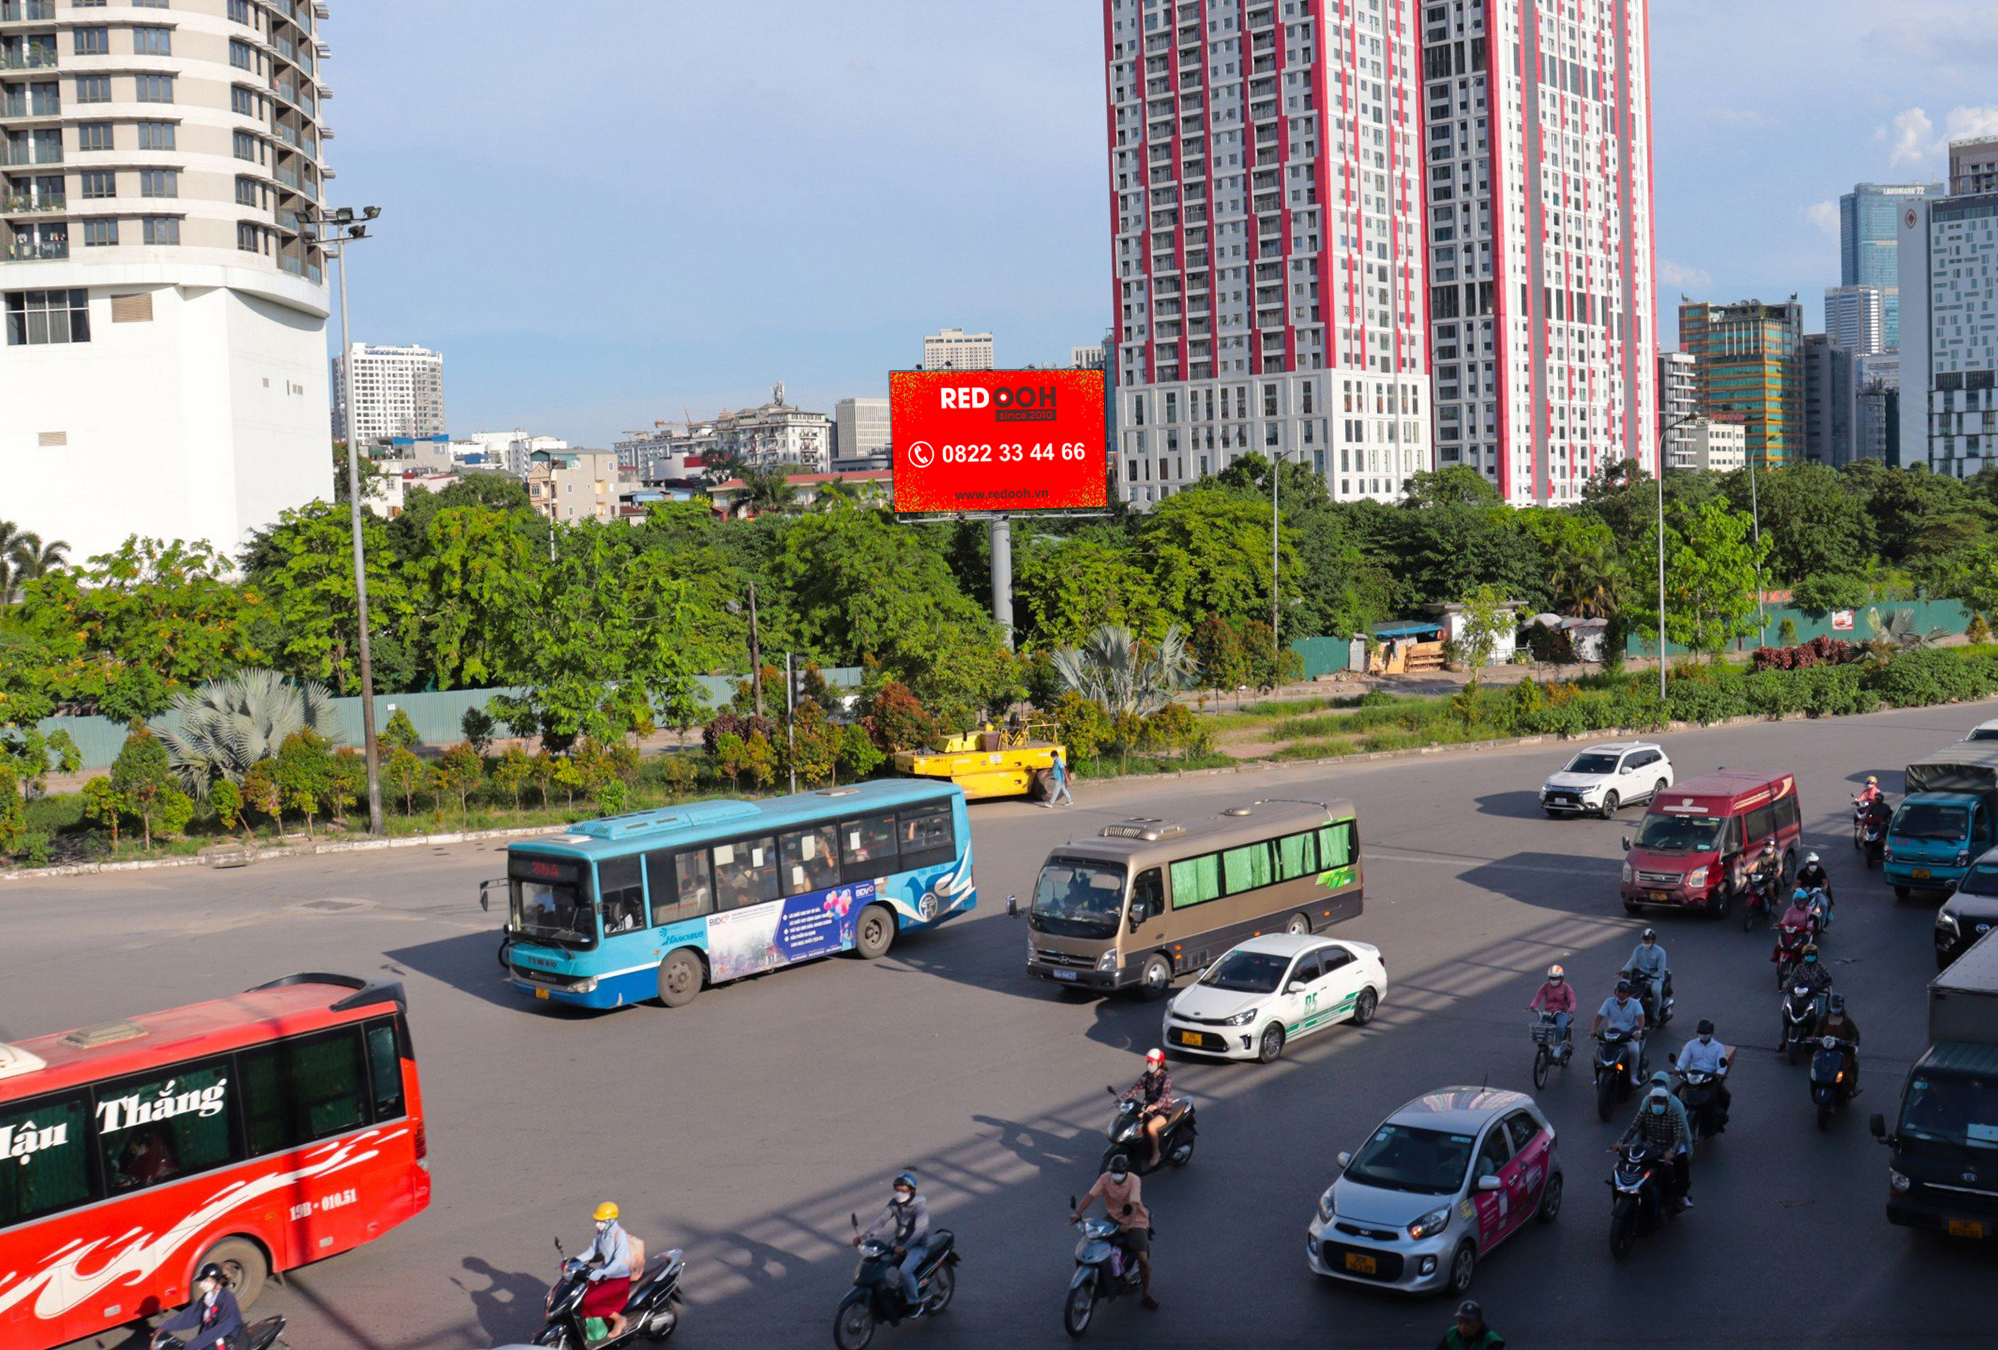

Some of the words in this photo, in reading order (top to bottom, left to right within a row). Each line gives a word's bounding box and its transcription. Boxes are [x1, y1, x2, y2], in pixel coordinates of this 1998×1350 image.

[1883, 187, 1915, 195] LANDMARK
[1916, 186, 1925, 195] 72
[940, 387, 990, 409] RED
[993, 386, 1057, 408] OOH
[999, 412, 1027, 420] since
[1030, 411, 1053, 420] 2010
[942, 444, 992, 463] 0822
[999, 443, 1023, 462] 33
[1030, 443, 1055, 461] 44
[1061, 442, 1086, 461] 66
[955, 488, 1049, 499] www.redooh.vn
[96, 1078, 228, 1135] Thắng
[289, 1201, 312, 1221] 19B
[321, 1188, 358, 1211] 010.51
